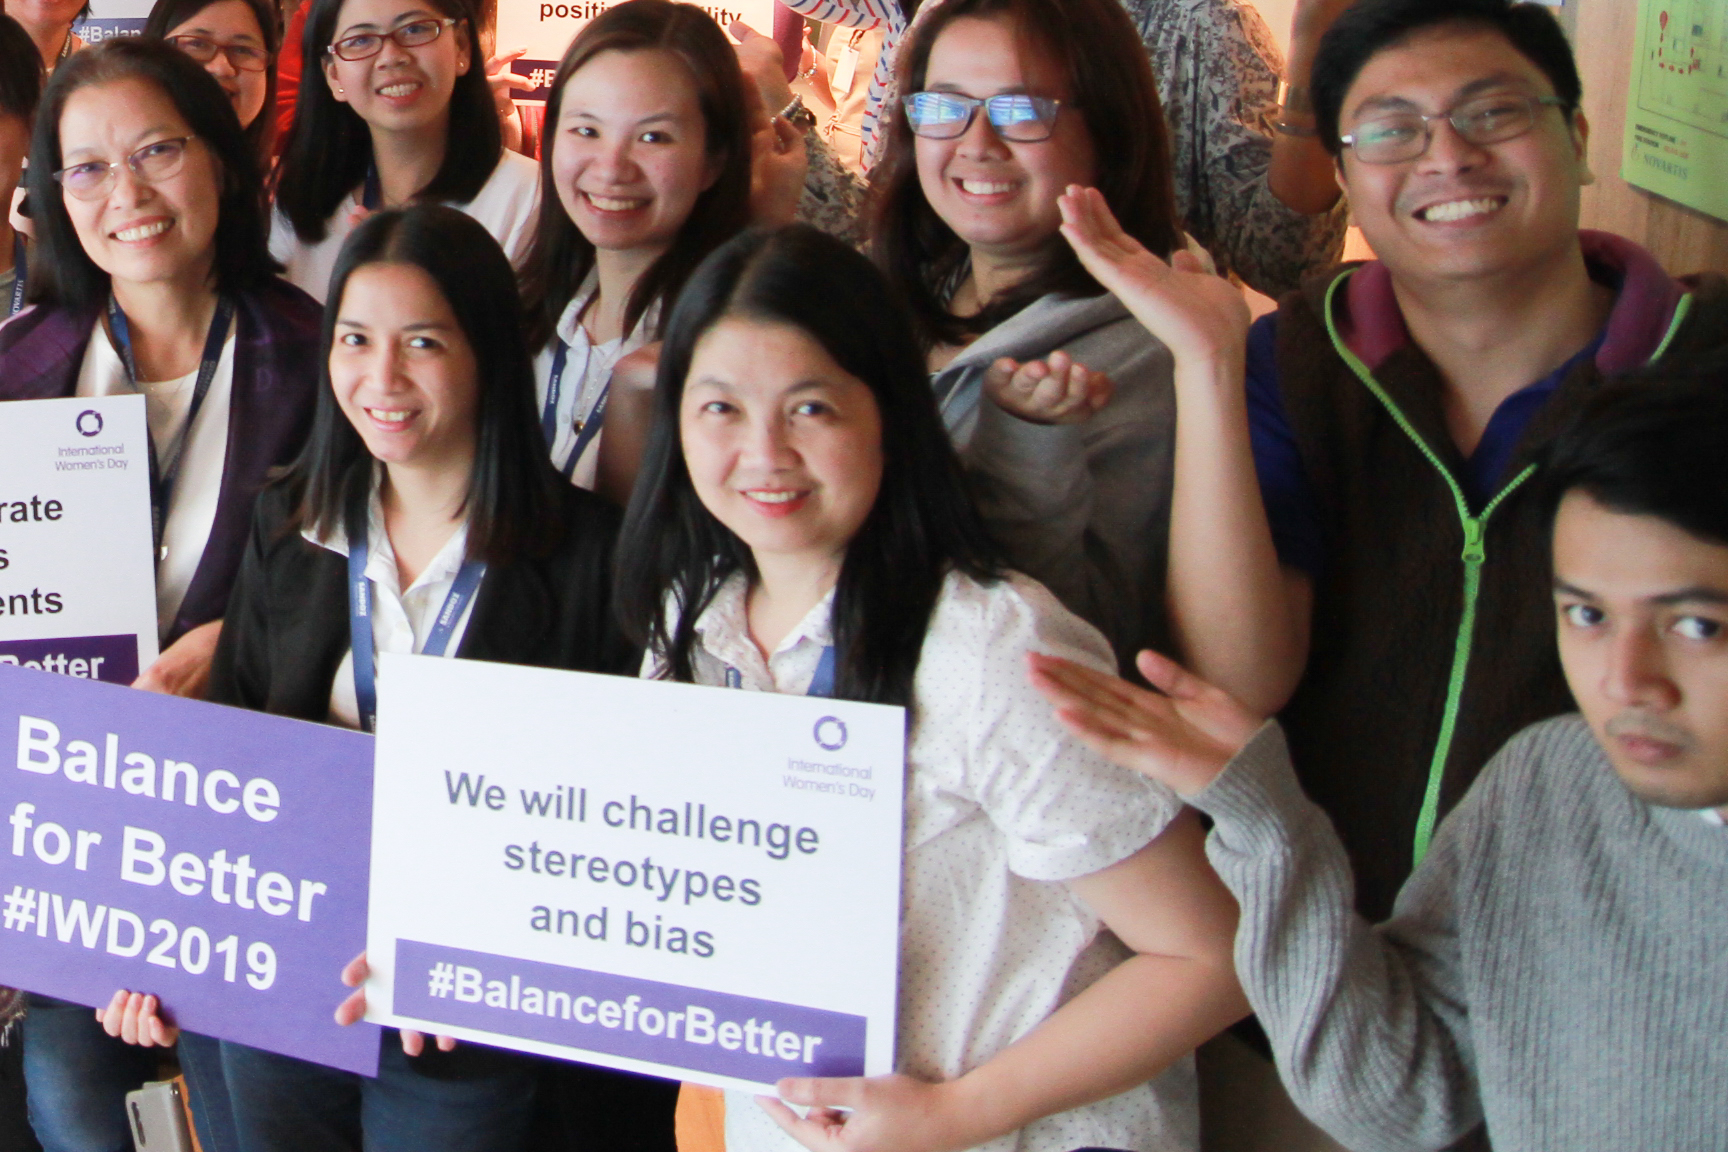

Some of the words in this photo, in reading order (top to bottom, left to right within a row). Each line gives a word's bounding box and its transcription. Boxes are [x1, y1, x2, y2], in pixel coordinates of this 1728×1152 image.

[1644, 153, 1689, 180] NOVARTIS
[55, 459, 104, 472] Women's
[107, 457, 129, 472] Day
[58, 442, 125, 457] International
[358, 581, 367, 617] SANDOZ
[440, 591, 461, 627] SANDOZ
[16, 715, 281, 822] Balance
[782, 774, 846, 796] Women's
[849, 781, 876, 802] Day
[787, 756, 872, 780] International
[445, 769, 506, 810] We
[519, 786, 587, 823] will
[603, 794, 820, 860] challenge
[9, 802, 102, 871] for
[120, 825, 327, 922] Better
[503, 841, 762, 907] stereotypes
[2, 885, 278, 991] #IWD2019
[530, 904, 608, 941] and
[626, 911, 716, 959] bias
[428, 960, 823, 1064] #BalanceforBetter
